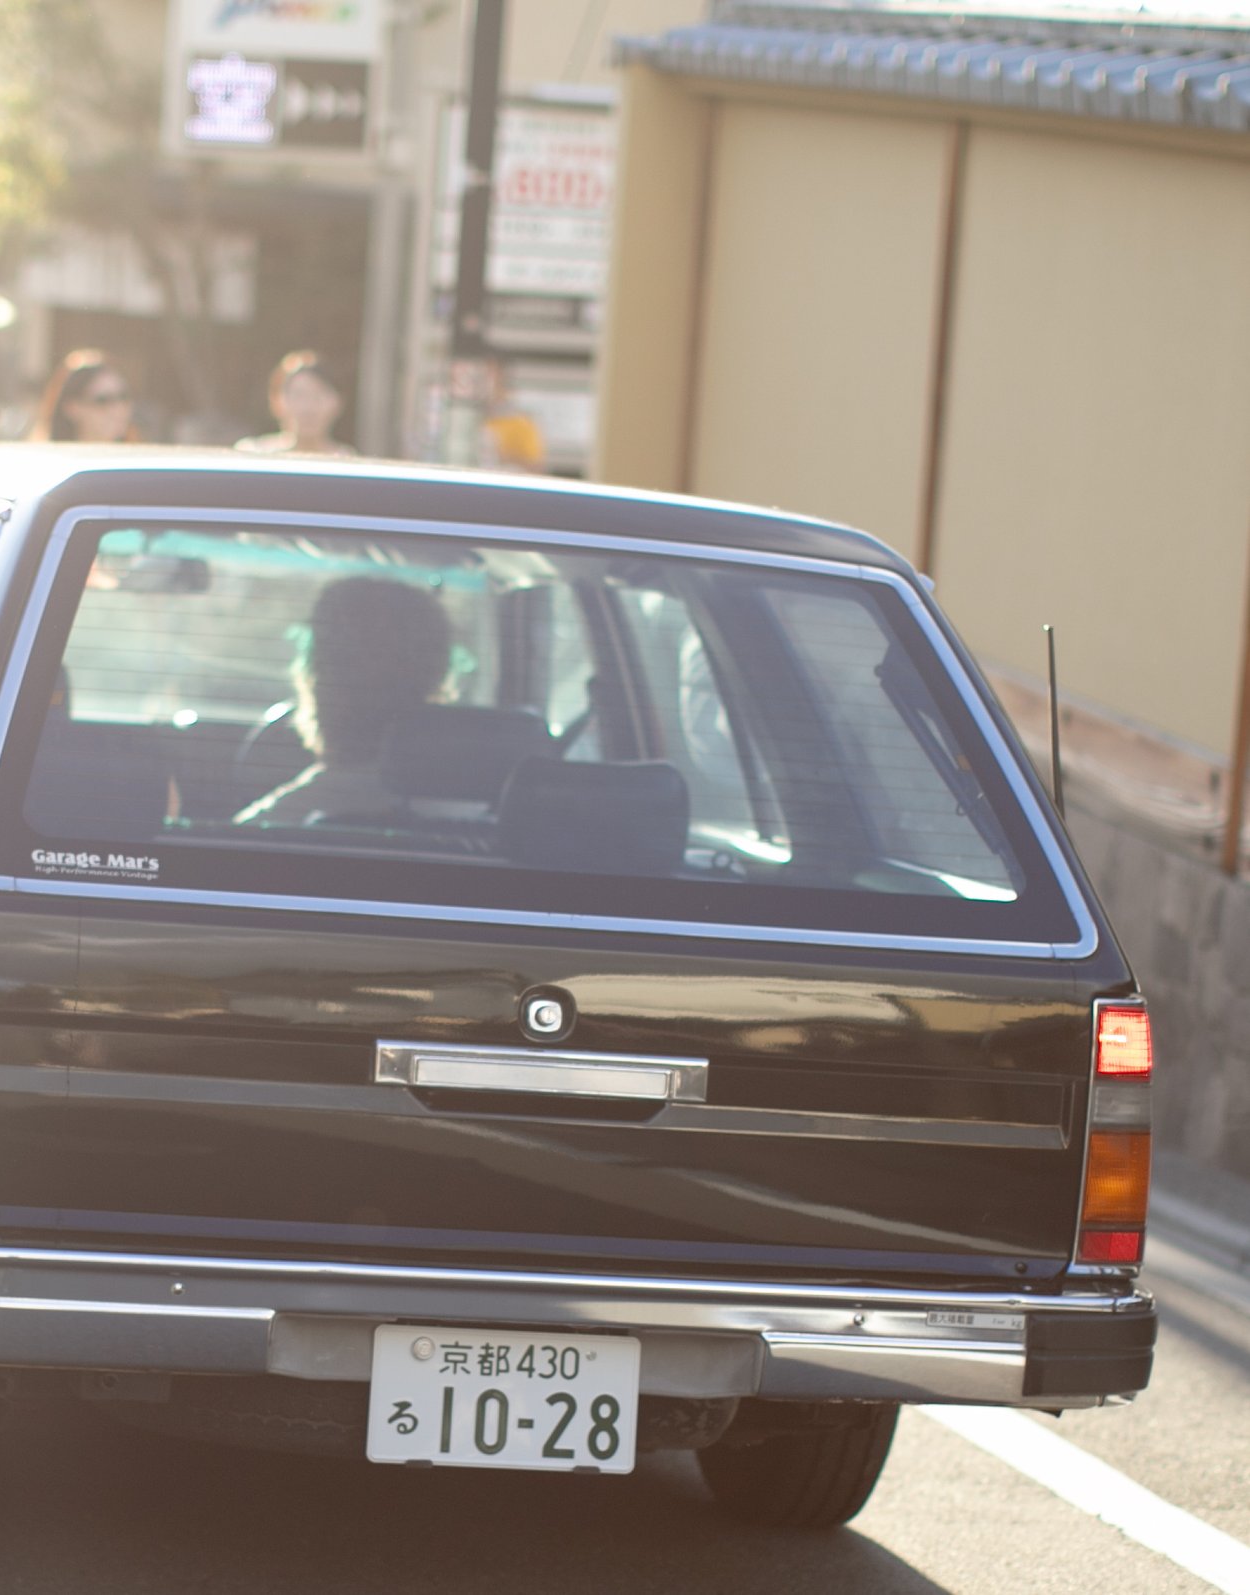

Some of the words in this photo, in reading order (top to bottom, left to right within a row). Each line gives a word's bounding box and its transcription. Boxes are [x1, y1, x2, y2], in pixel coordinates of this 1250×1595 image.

[31, 849, 101, 868] Garage
[107, 854, 159, 871] Mar's
[121, 870, 159, 880] Vintage
[387, 1400, 419, 1435] る
[439, 1386, 620, 1461] 10-28
